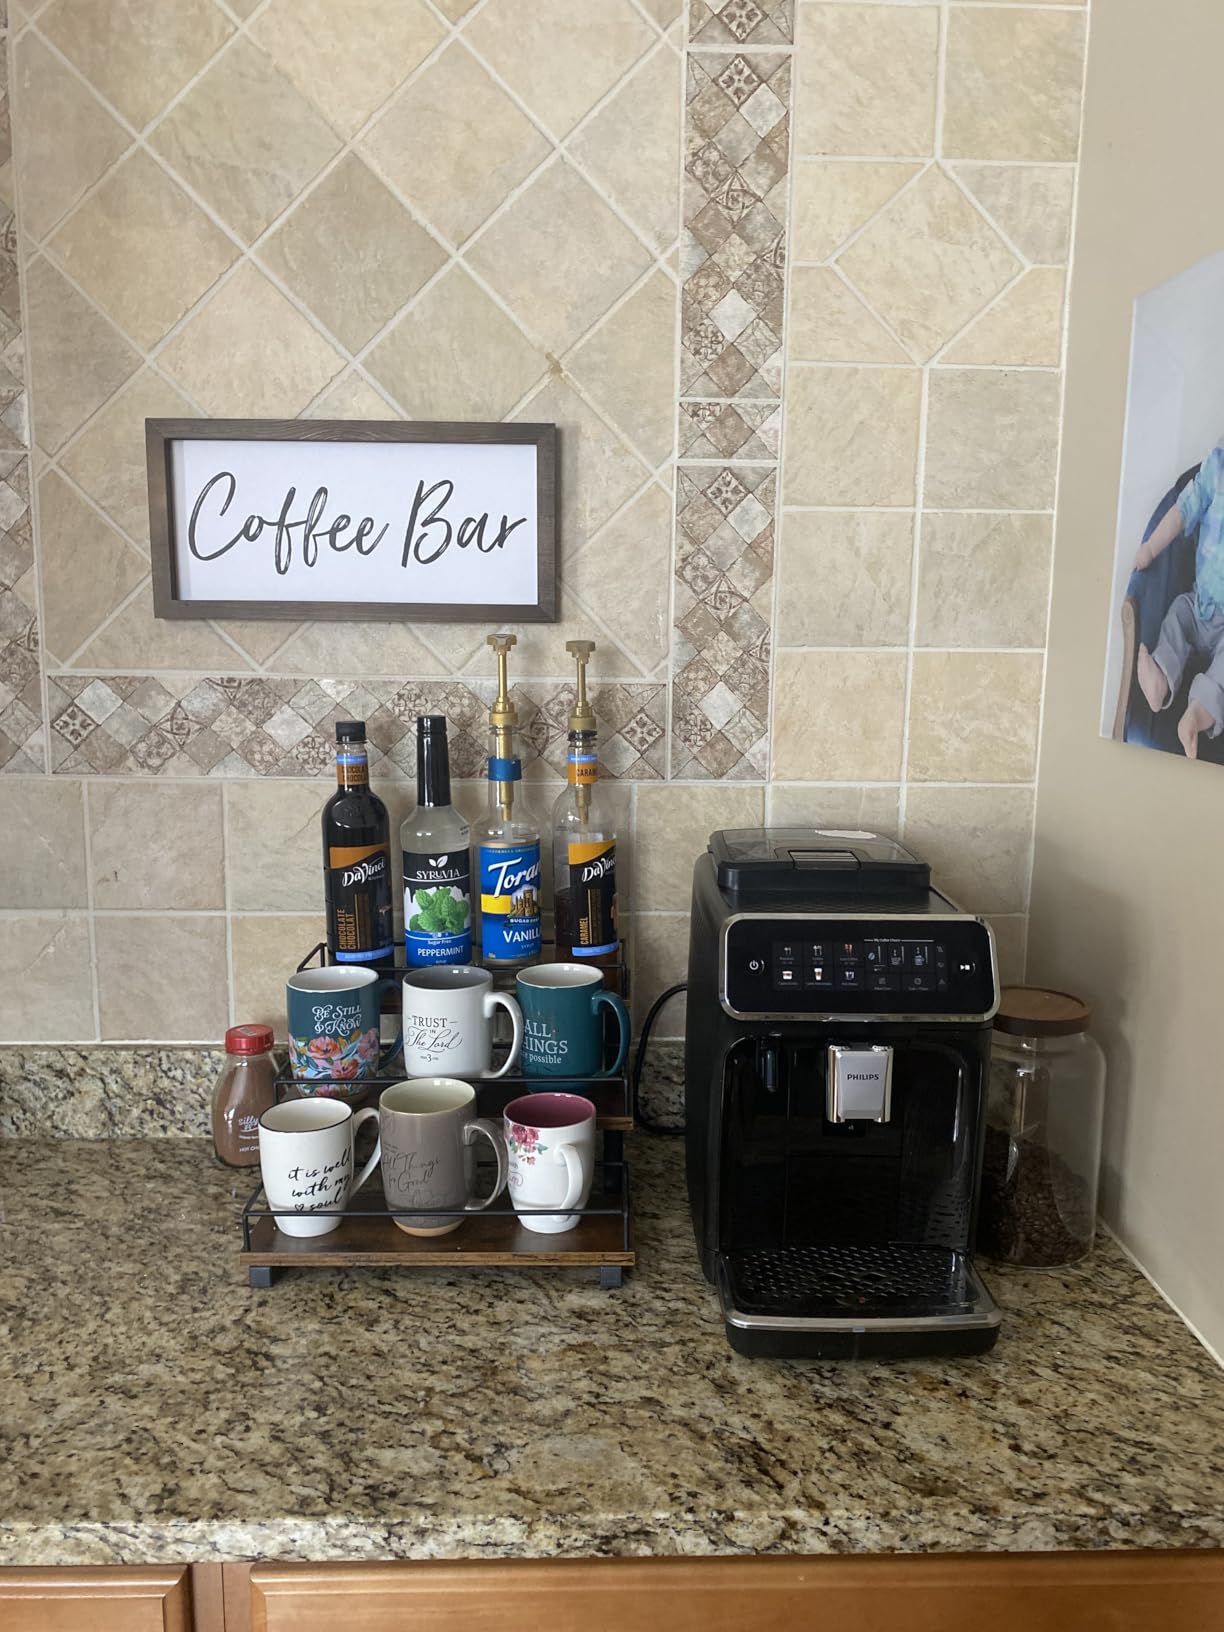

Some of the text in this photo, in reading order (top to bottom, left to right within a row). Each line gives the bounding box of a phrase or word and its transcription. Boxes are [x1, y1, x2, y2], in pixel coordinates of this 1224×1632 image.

[188, 471, 528, 575] Coffee Bar
[342, 856, 385, 887] DaVinci
[416, 868, 461, 880] SYRUVIA
[337, 909, 346, 950] CHOCOLATE
[346, 913, 356, 950] CHOCOLAT
[579, 917, 589, 944] CARAMEL
[417, 945, 464, 957] PEPPERMINT
[412, 1015, 448, 1028] TRUST
[525, 1019, 551, 1038] ALL
[407, 1026, 463, 1053] The Lord
[529, 1053, 562, 1064] possible
[288, 1145, 351, 1181] it is well
[291, 1174, 351, 1197] with my
[310, 1186, 342, 1211] soul
